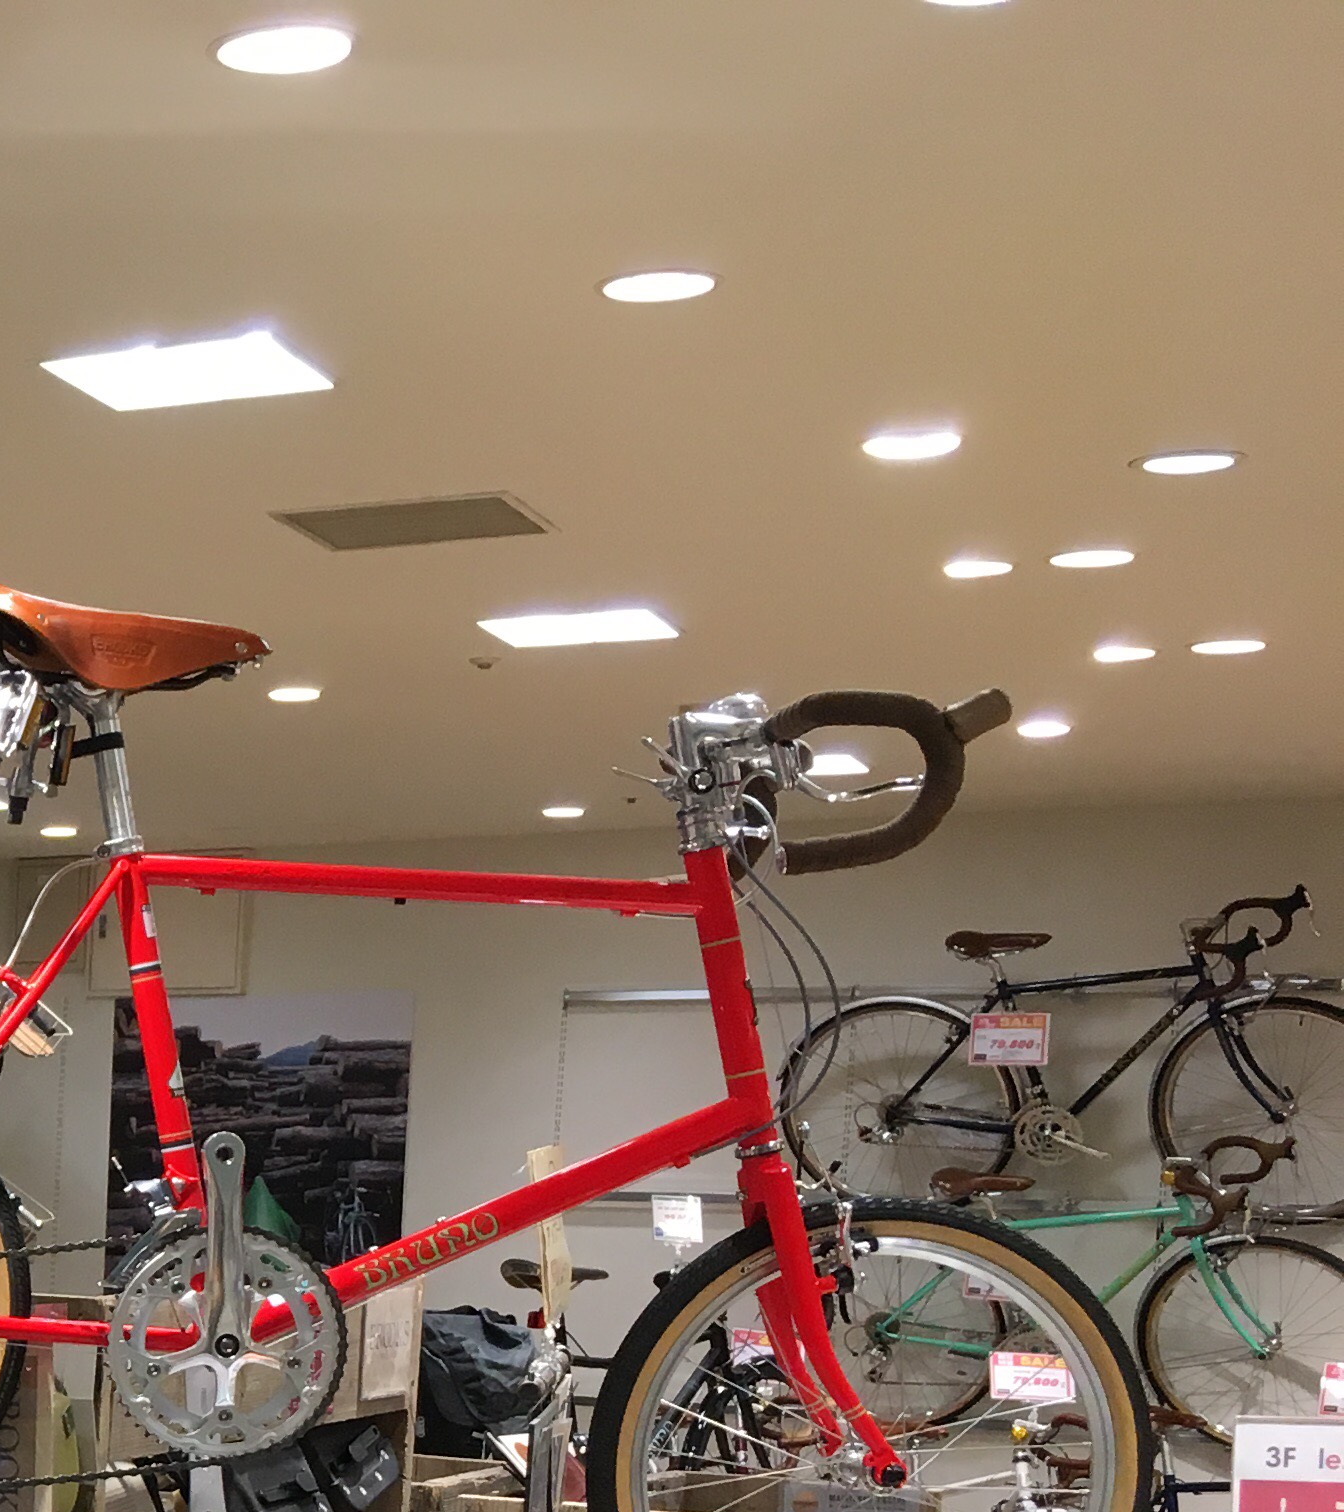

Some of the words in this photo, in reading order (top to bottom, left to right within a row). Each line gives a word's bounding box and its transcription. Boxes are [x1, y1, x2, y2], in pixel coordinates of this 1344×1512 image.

[999, 1017, 1044, 1027] SALE
[354, 1212, 499, 1291] BRUNO
[1265, 1445, 1297, 1468] 3F
